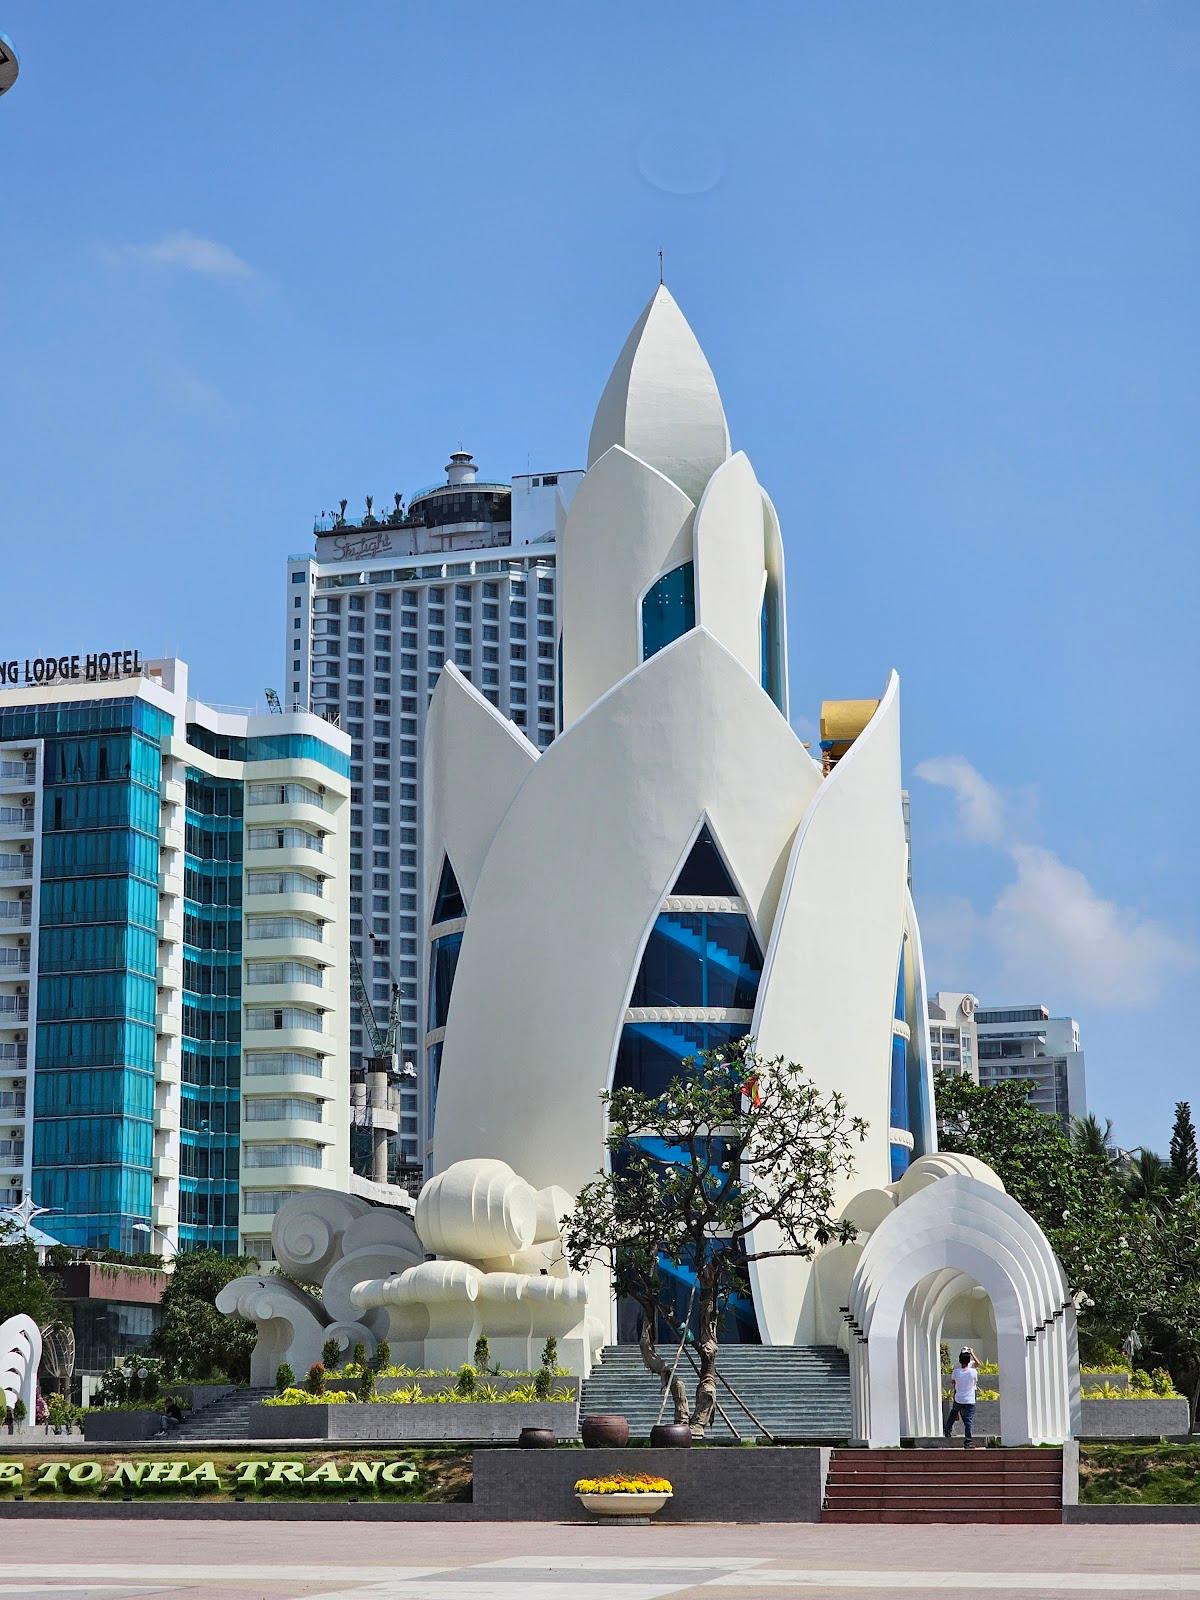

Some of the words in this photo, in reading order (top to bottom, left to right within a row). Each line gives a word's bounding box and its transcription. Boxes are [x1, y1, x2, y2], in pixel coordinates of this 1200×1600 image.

[333, 533, 392, 560] Skylight
[25, 656, 80, 682] LODGE
[86, 650, 142, 681] HOTEL
[38, 1462, 102, 1487] TO
[105, 1461, 221, 1487] NHA
[236, 1461, 419, 1486] TRANG
